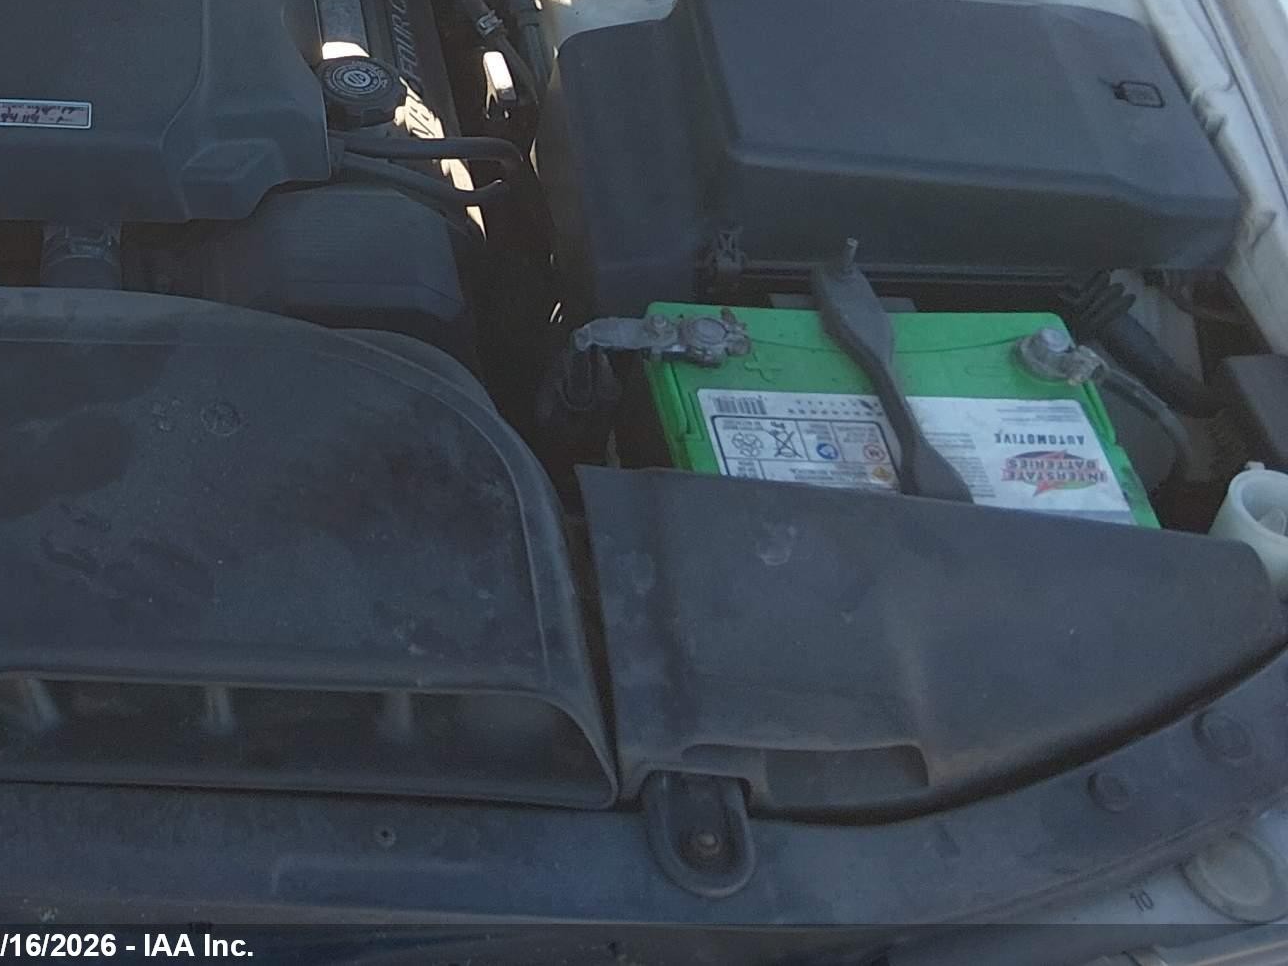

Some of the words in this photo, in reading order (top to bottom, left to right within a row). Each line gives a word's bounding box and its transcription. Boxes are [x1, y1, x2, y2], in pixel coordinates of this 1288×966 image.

[392, 14, 422, 81] FOUR
[994, 433, 1085, 445] AUTOMOTIVE
[1007, 459, 1097, 471] BATTERIES
[1009, 471, 1108, 483] INTERSTATE
